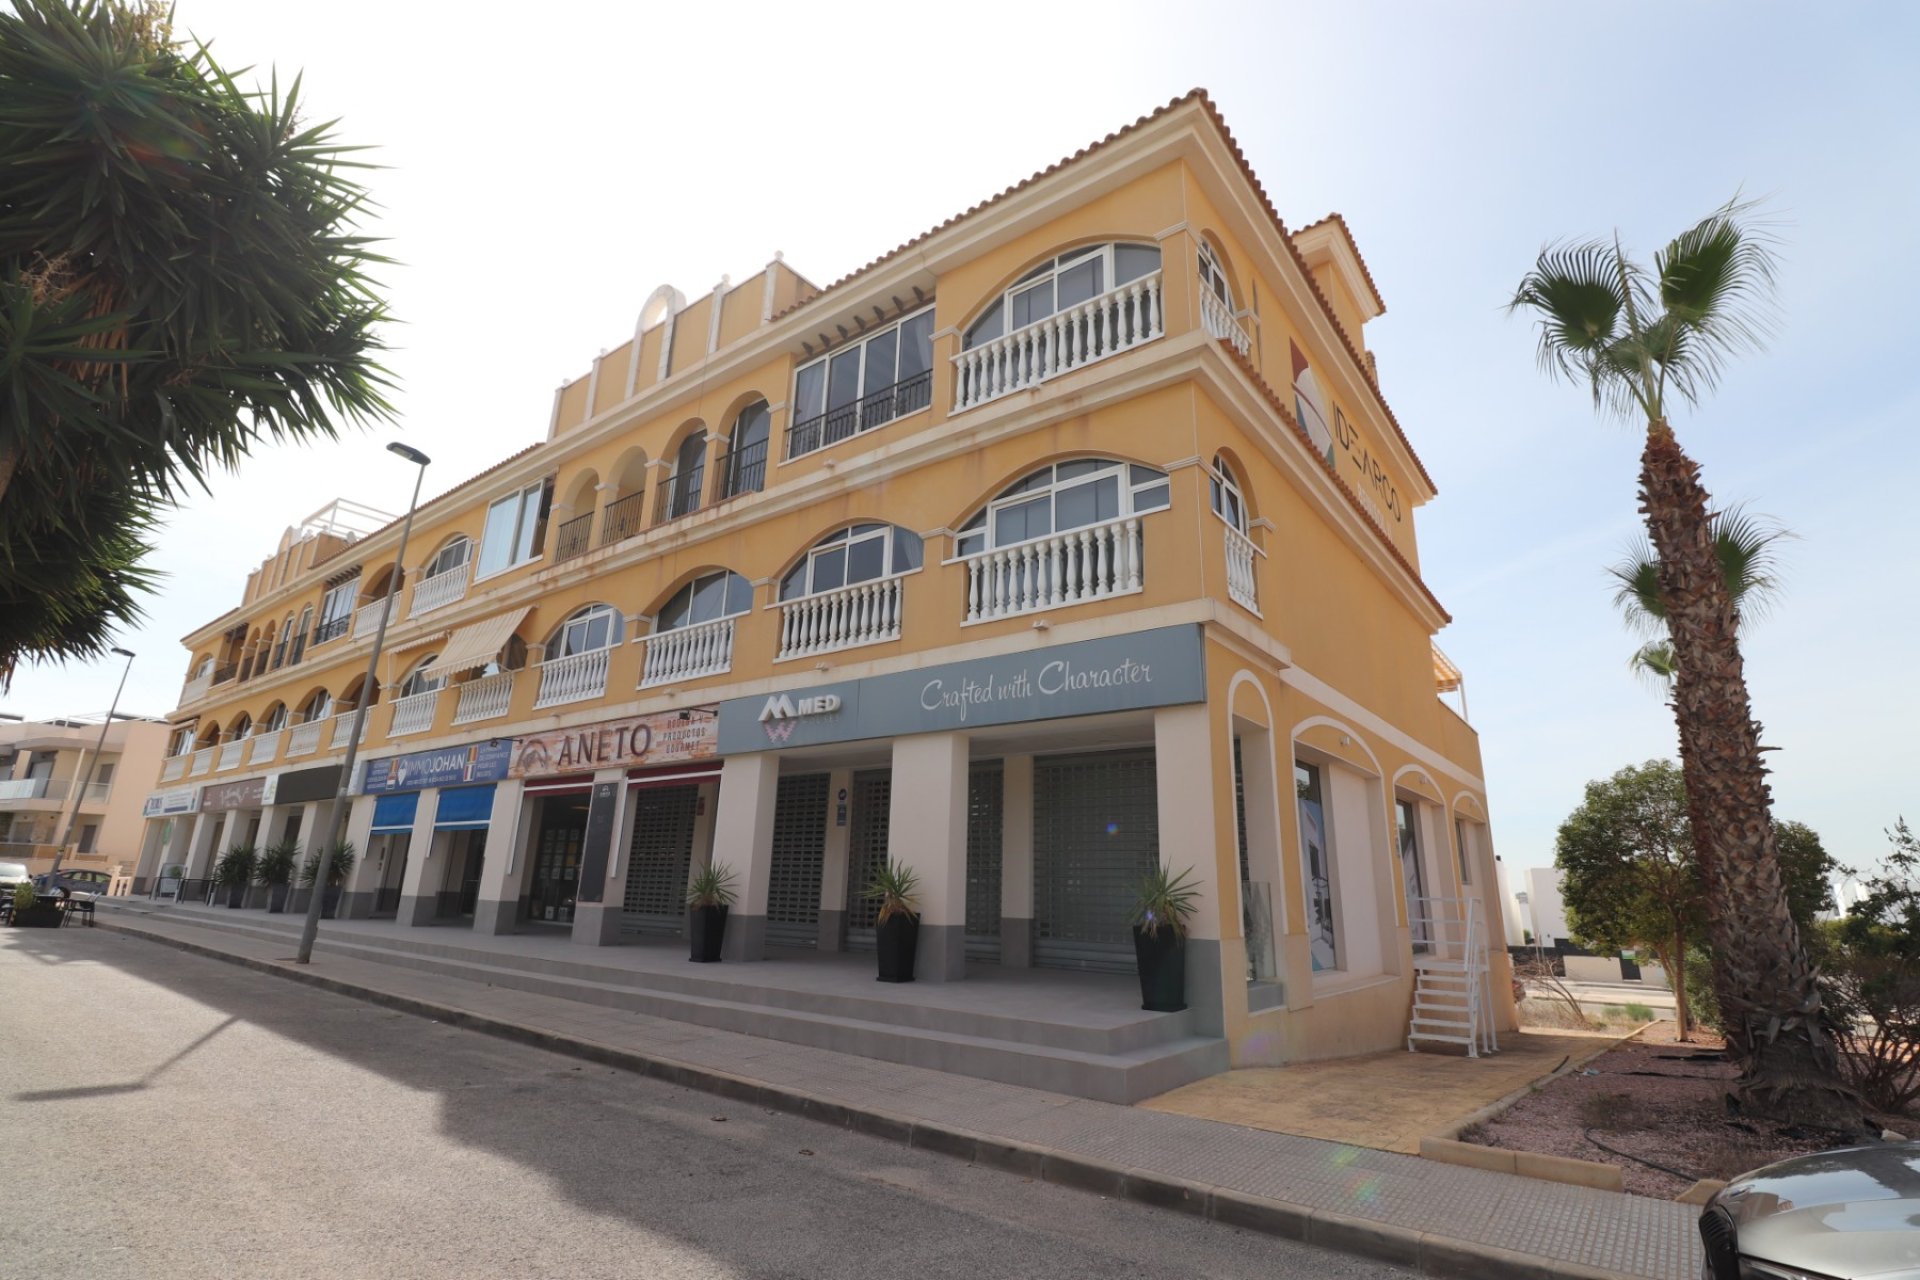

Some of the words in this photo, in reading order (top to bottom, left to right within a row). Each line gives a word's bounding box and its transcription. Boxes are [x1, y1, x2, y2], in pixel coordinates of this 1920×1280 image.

[921, 674, 994, 721] Crafted
[998, 669, 1033, 701] with
[1038, 657, 1152, 695] Character
[798, 695, 840, 715] MED
[558, 724, 650, 766] ANETO
[662, 727, 706, 741] PRODUCTOS
